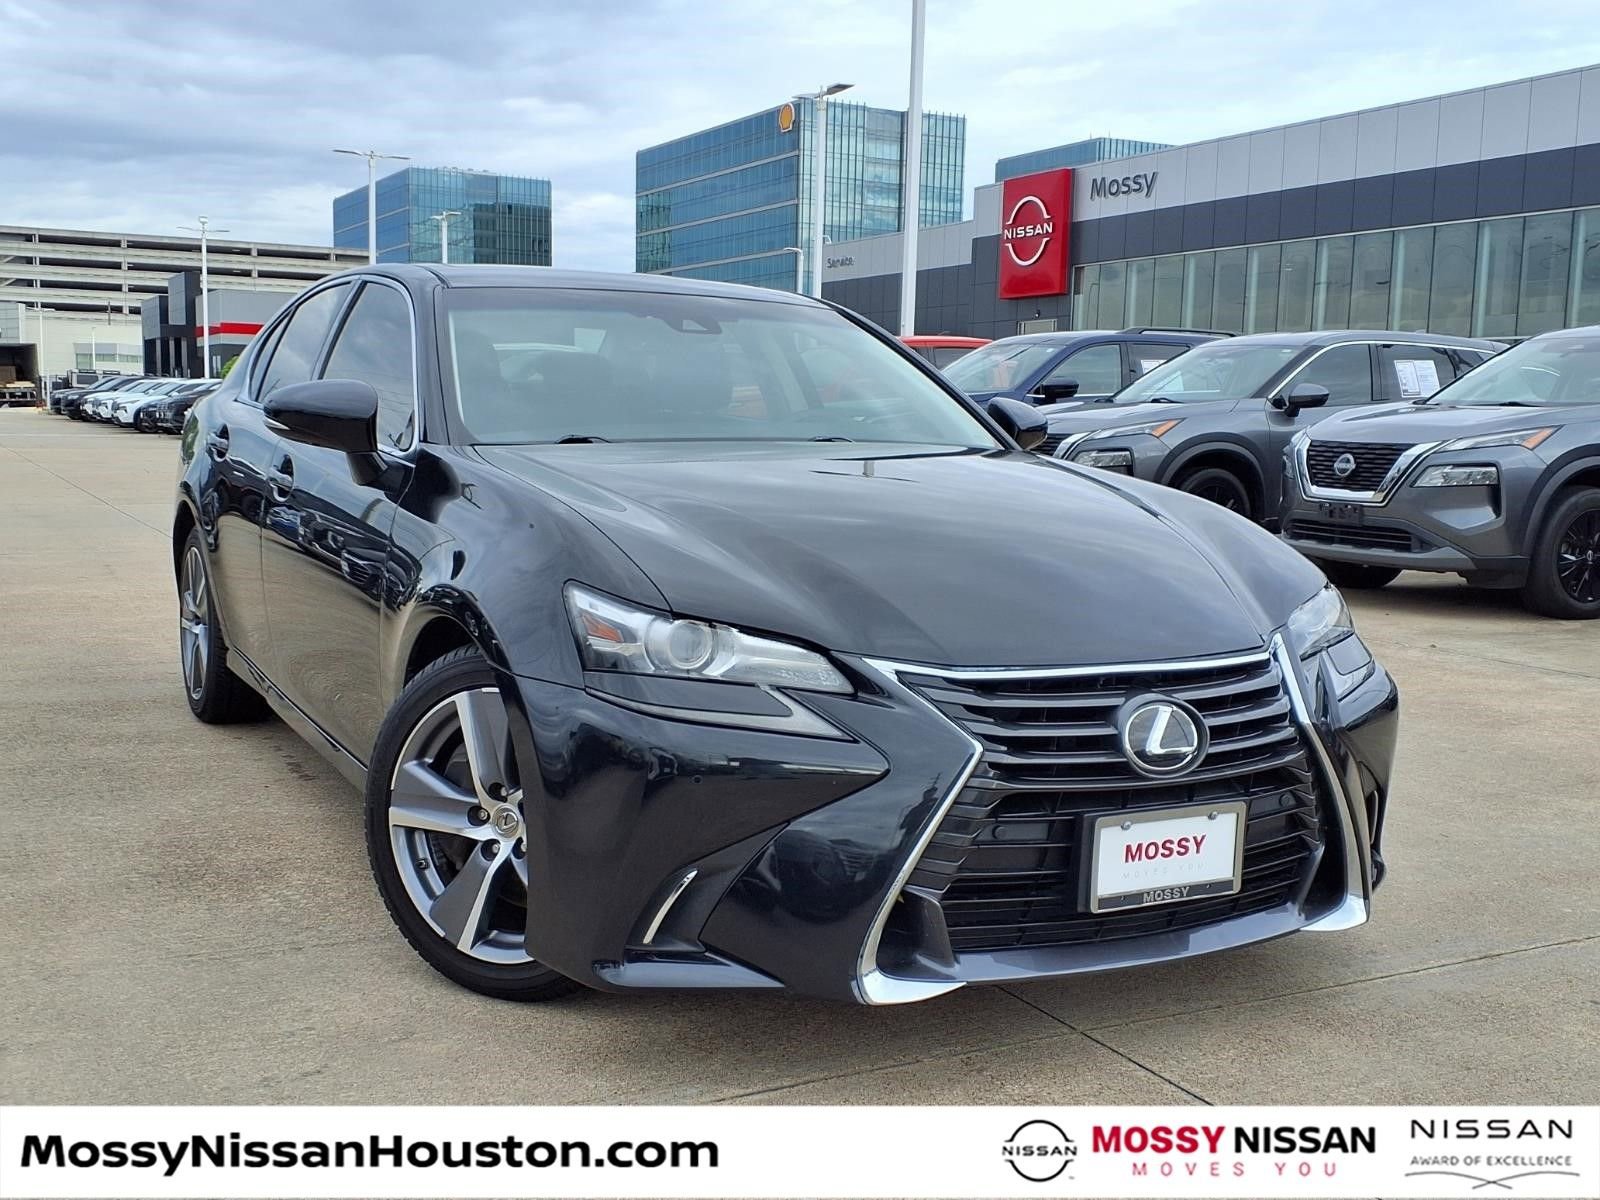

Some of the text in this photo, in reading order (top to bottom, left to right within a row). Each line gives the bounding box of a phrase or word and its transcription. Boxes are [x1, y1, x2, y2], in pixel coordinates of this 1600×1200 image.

[1090, 171, 1158, 201] Mossy
[1004, 222, 1053, 240] NISSAN
[1124, 834, 1207, 864] MOSSY
[1143, 886, 1190, 904] MOSSY
